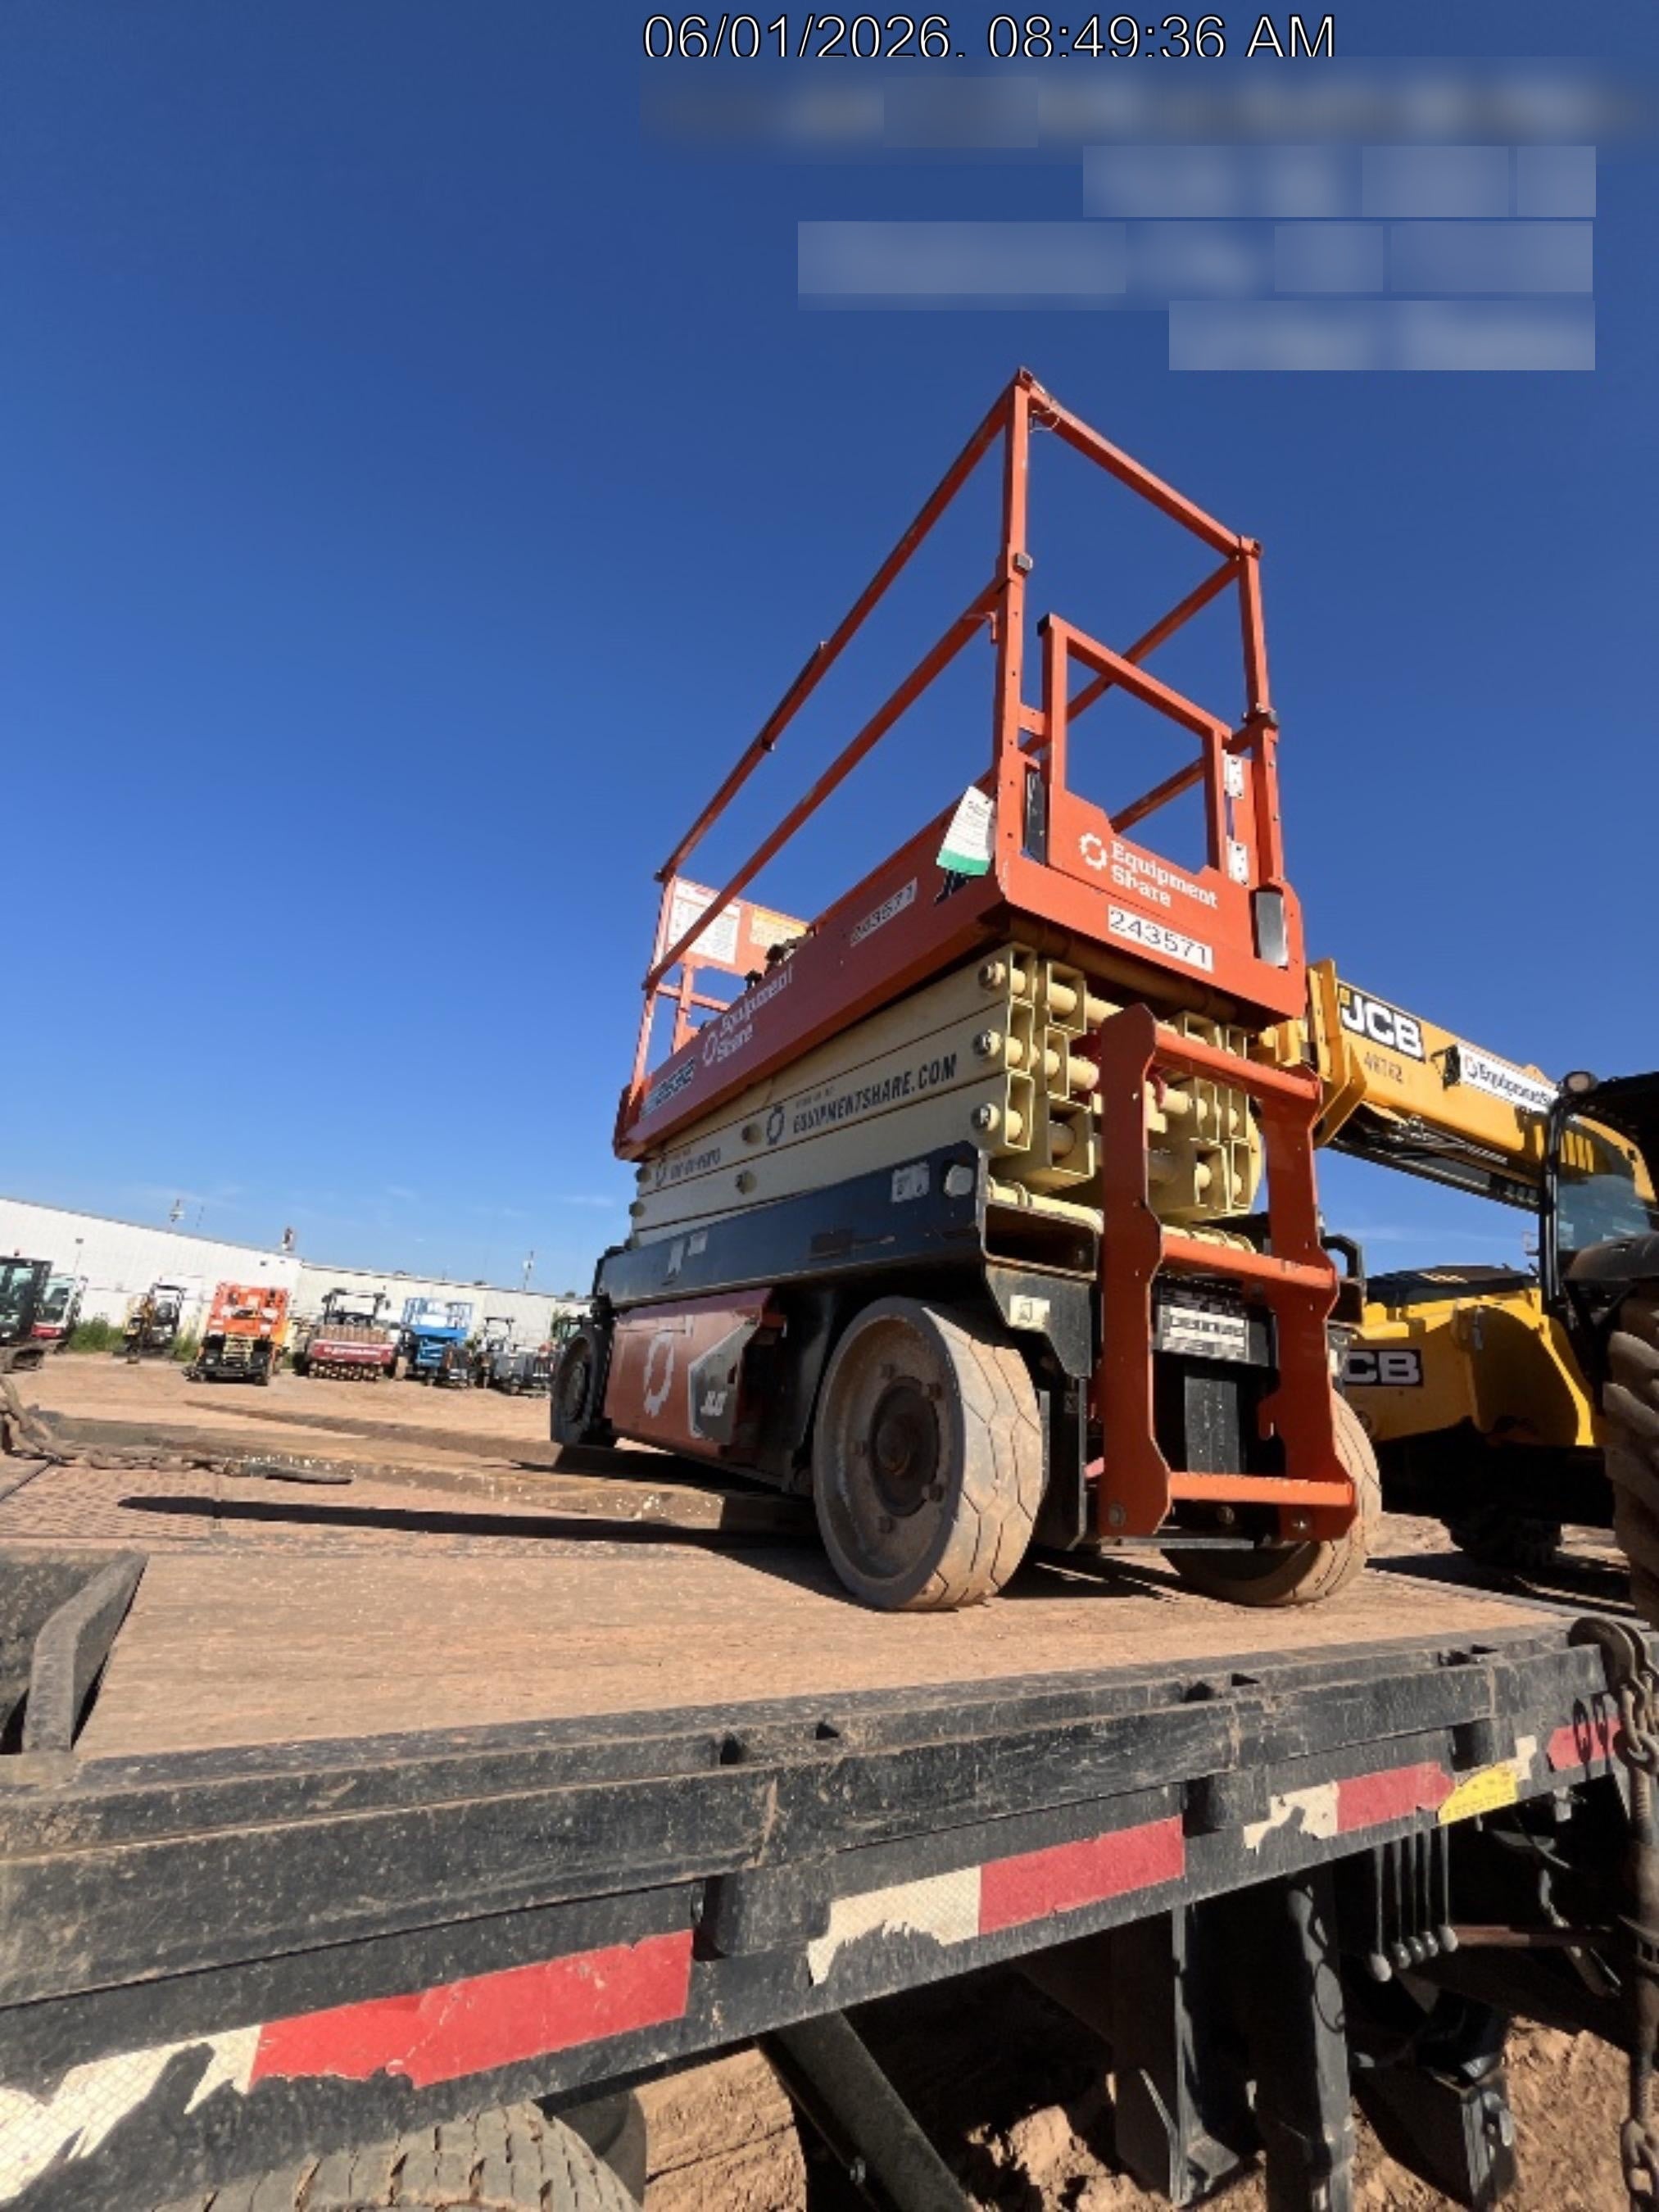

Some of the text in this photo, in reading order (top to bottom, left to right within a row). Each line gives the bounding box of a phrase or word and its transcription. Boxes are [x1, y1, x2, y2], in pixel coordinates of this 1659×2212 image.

[1111, 840, 1218, 909] Equipment
[1111, 865, 1172, 909] Share
[1110, 909, 1208, 965] 243571
[1341, 994, 1424, 1059] JCB
[1343, 1350, 1420, 1385] CB
